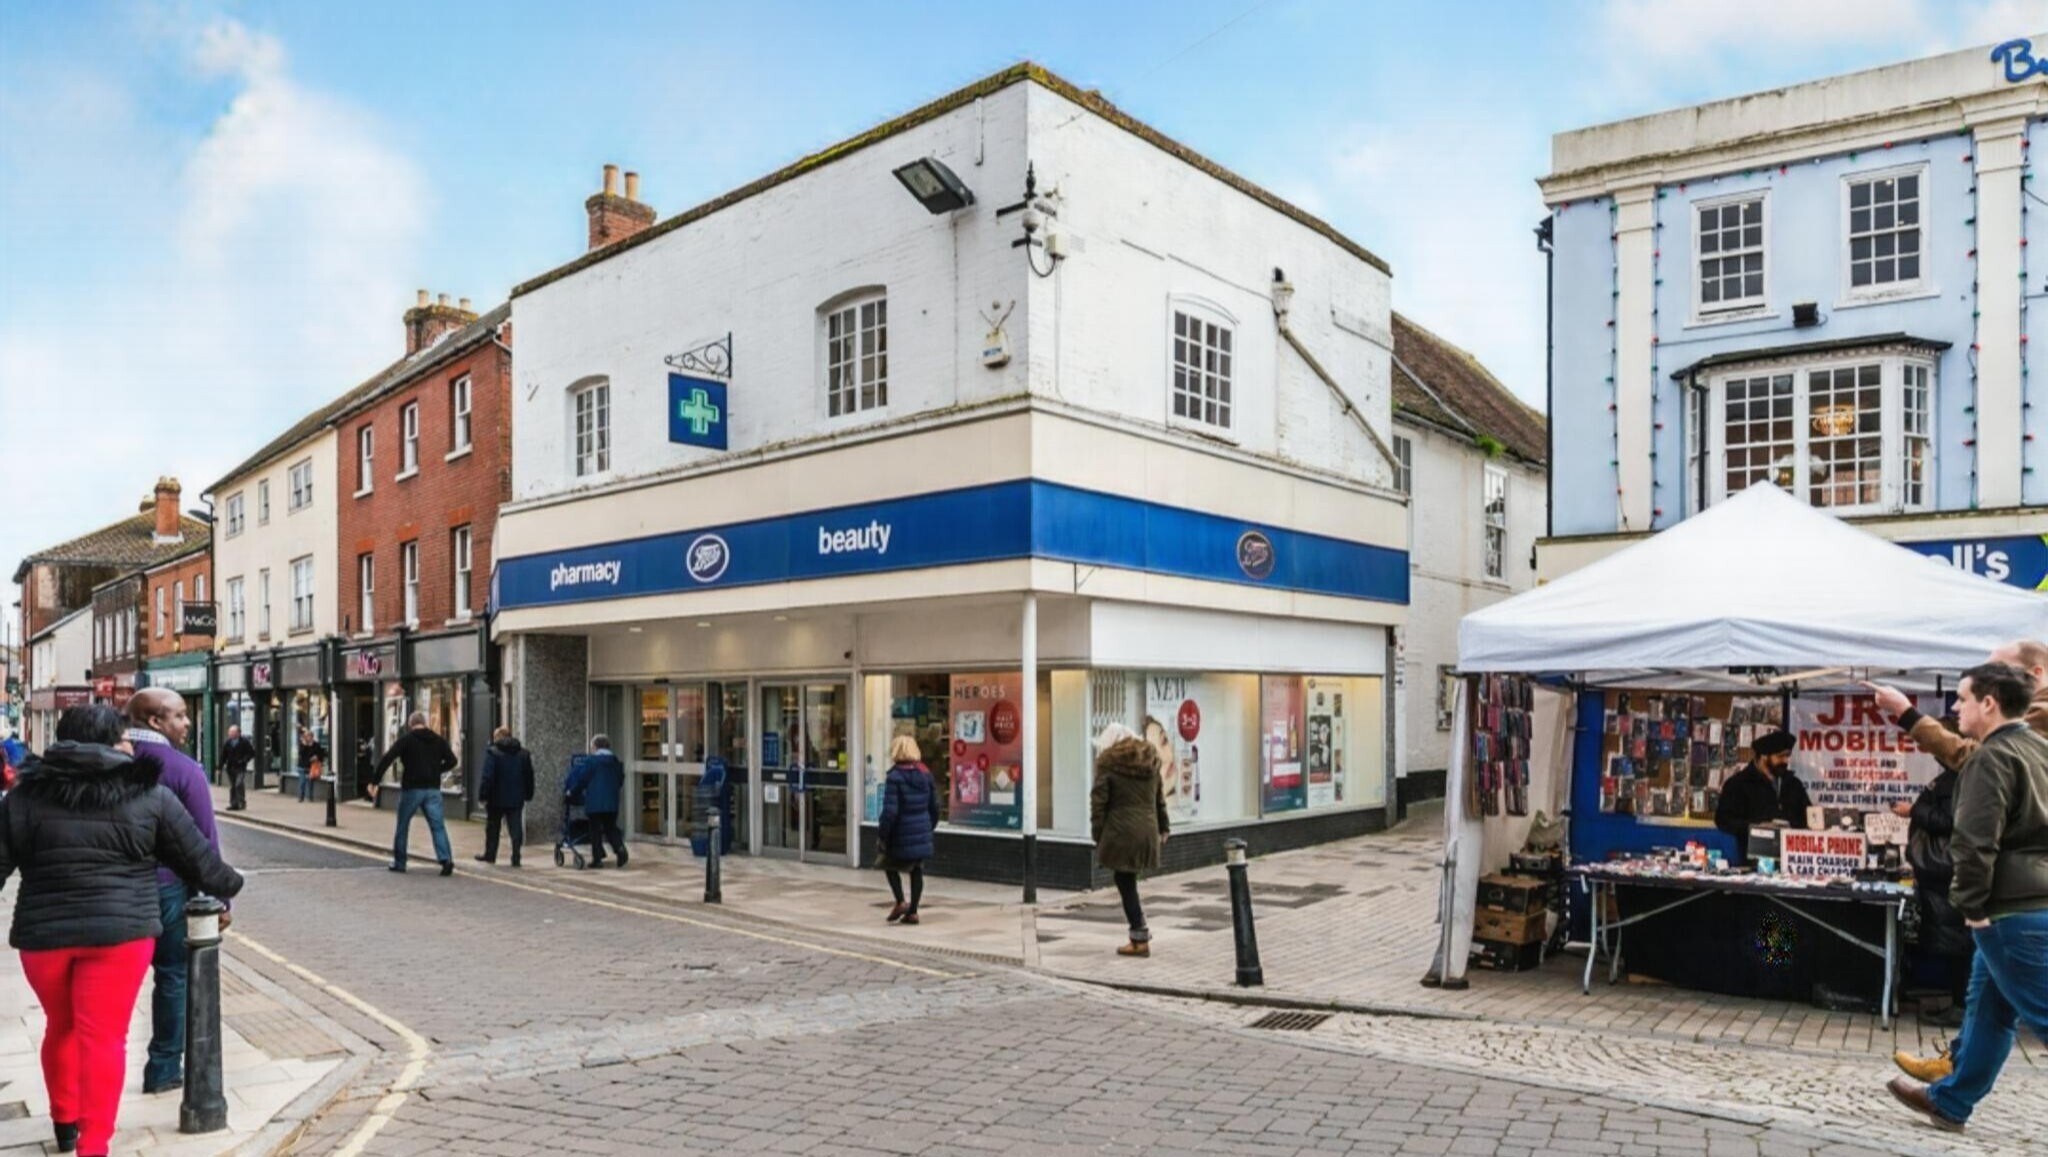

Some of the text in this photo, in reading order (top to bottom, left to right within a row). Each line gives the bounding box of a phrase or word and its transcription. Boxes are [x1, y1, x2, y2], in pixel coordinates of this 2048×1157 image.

[819, 519, 891, 554] beauty
[550, 560, 621, 592] pharmacy
[954, 684, 1006, 699] HEROES
[1799, 730, 1932, 753] MOBILE
[1810, 781, 1868, 792] REPLACEMENT
[1887, 783, 1902, 794] ALL
[1818, 794, 1834, 803] AND
[1786, 834, 1863, 856] MOBILE PHONE
[1788, 855, 1859, 868] MAIN CHARGER
[1796, 865, 1815, 876] CAR
